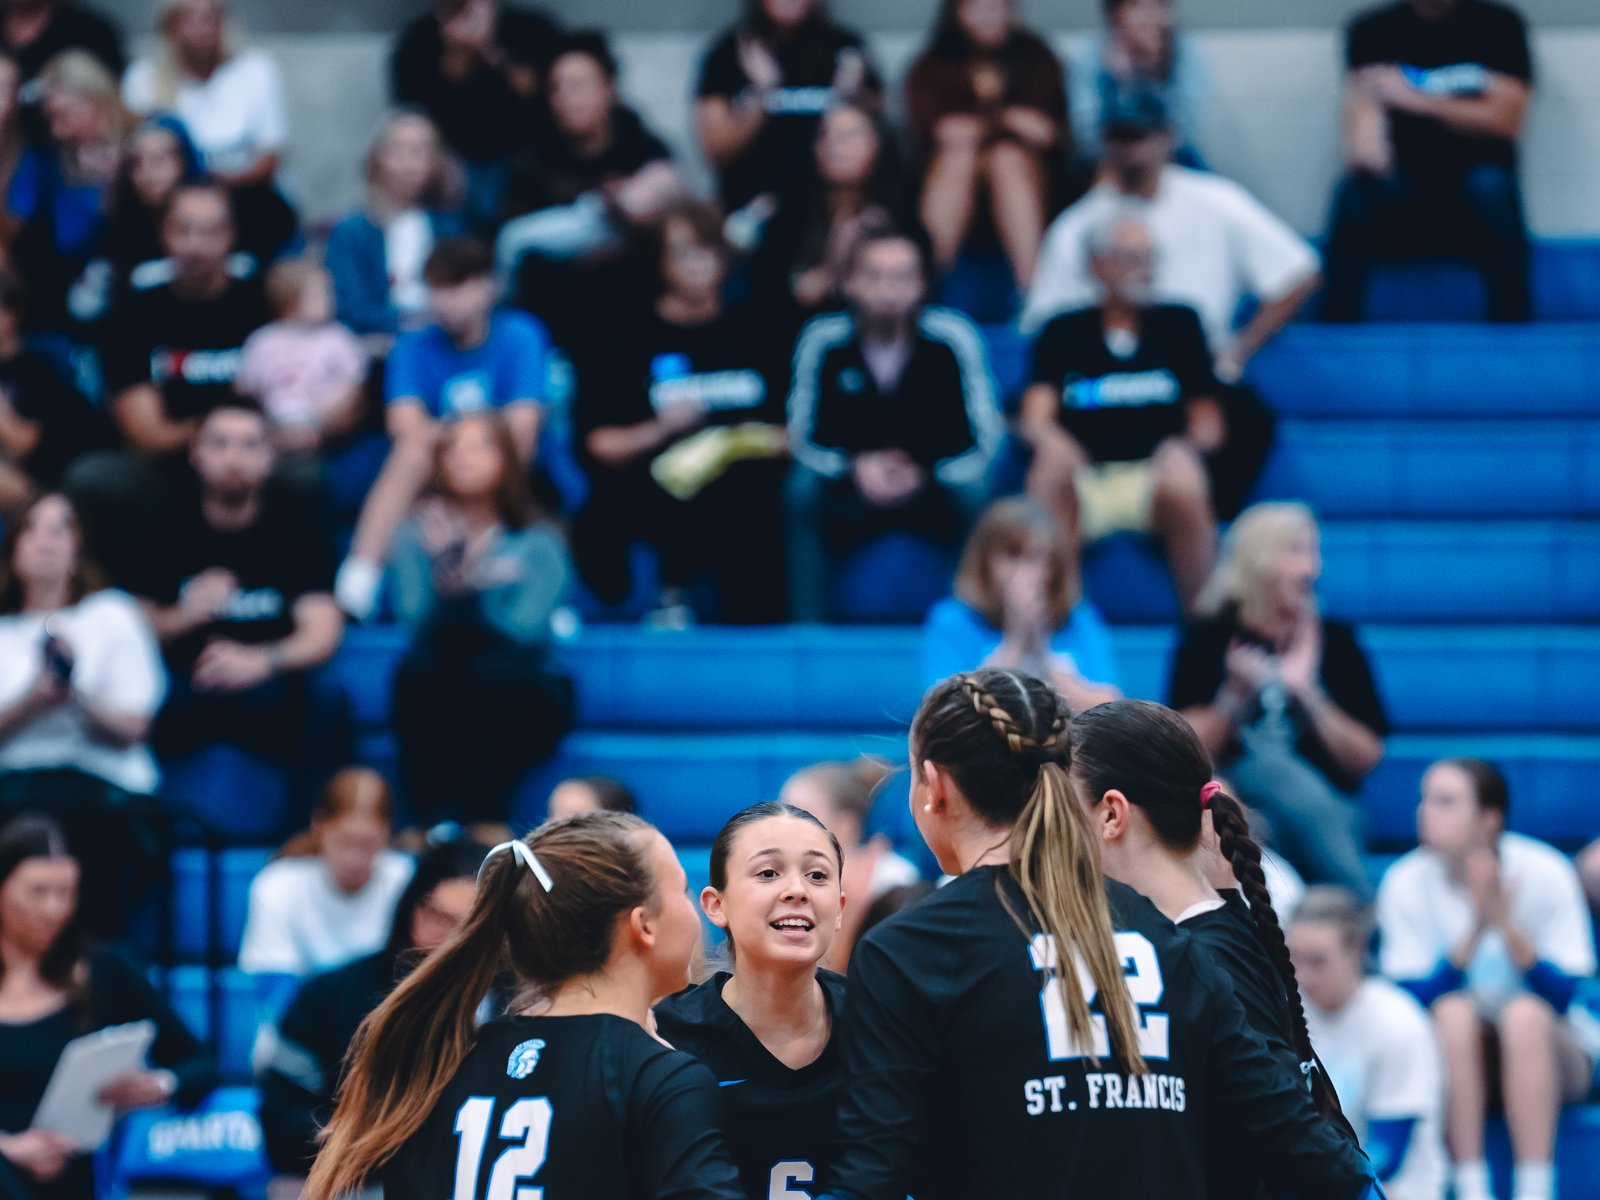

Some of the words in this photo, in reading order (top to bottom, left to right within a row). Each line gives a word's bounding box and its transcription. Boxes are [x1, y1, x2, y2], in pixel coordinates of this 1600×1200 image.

[1027, 930, 1170, 1063] 22
[1024, 1075, 1078, 1116] ST.
[1085, 1072, 1187, 1113] FRANCIS
